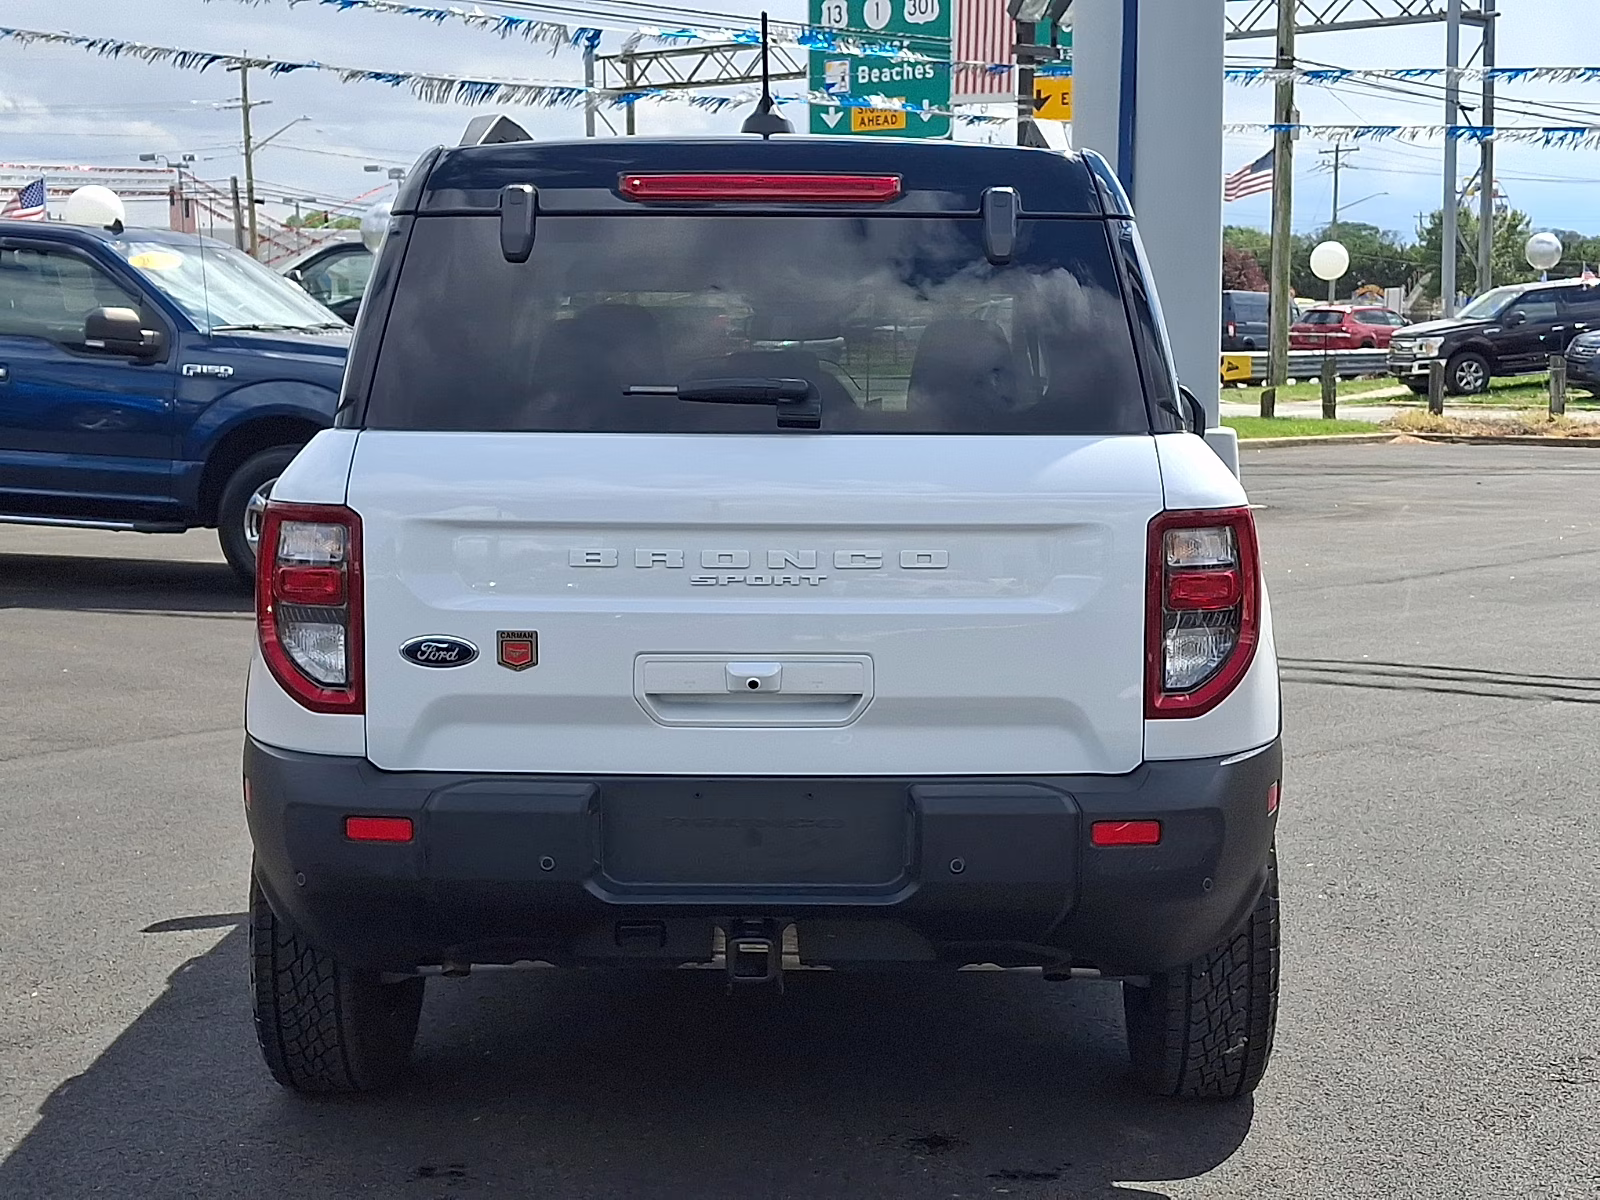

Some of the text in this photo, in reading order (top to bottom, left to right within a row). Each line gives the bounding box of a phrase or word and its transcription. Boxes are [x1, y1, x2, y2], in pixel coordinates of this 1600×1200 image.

[826, 5, 843, 24] 13
[874, 1, 880, 21] 1
[907, 0, 935, 16] 301
[857, 62, 935, 84] Beaches
[859, 114, 898, 127] AHEAD
[567, 547, 950, 570] BRONCO
[689, 573, 828, 587] SPORT
[500, 631, 533, 639] CARMAN
[415, 641, 461, 664] Ford
